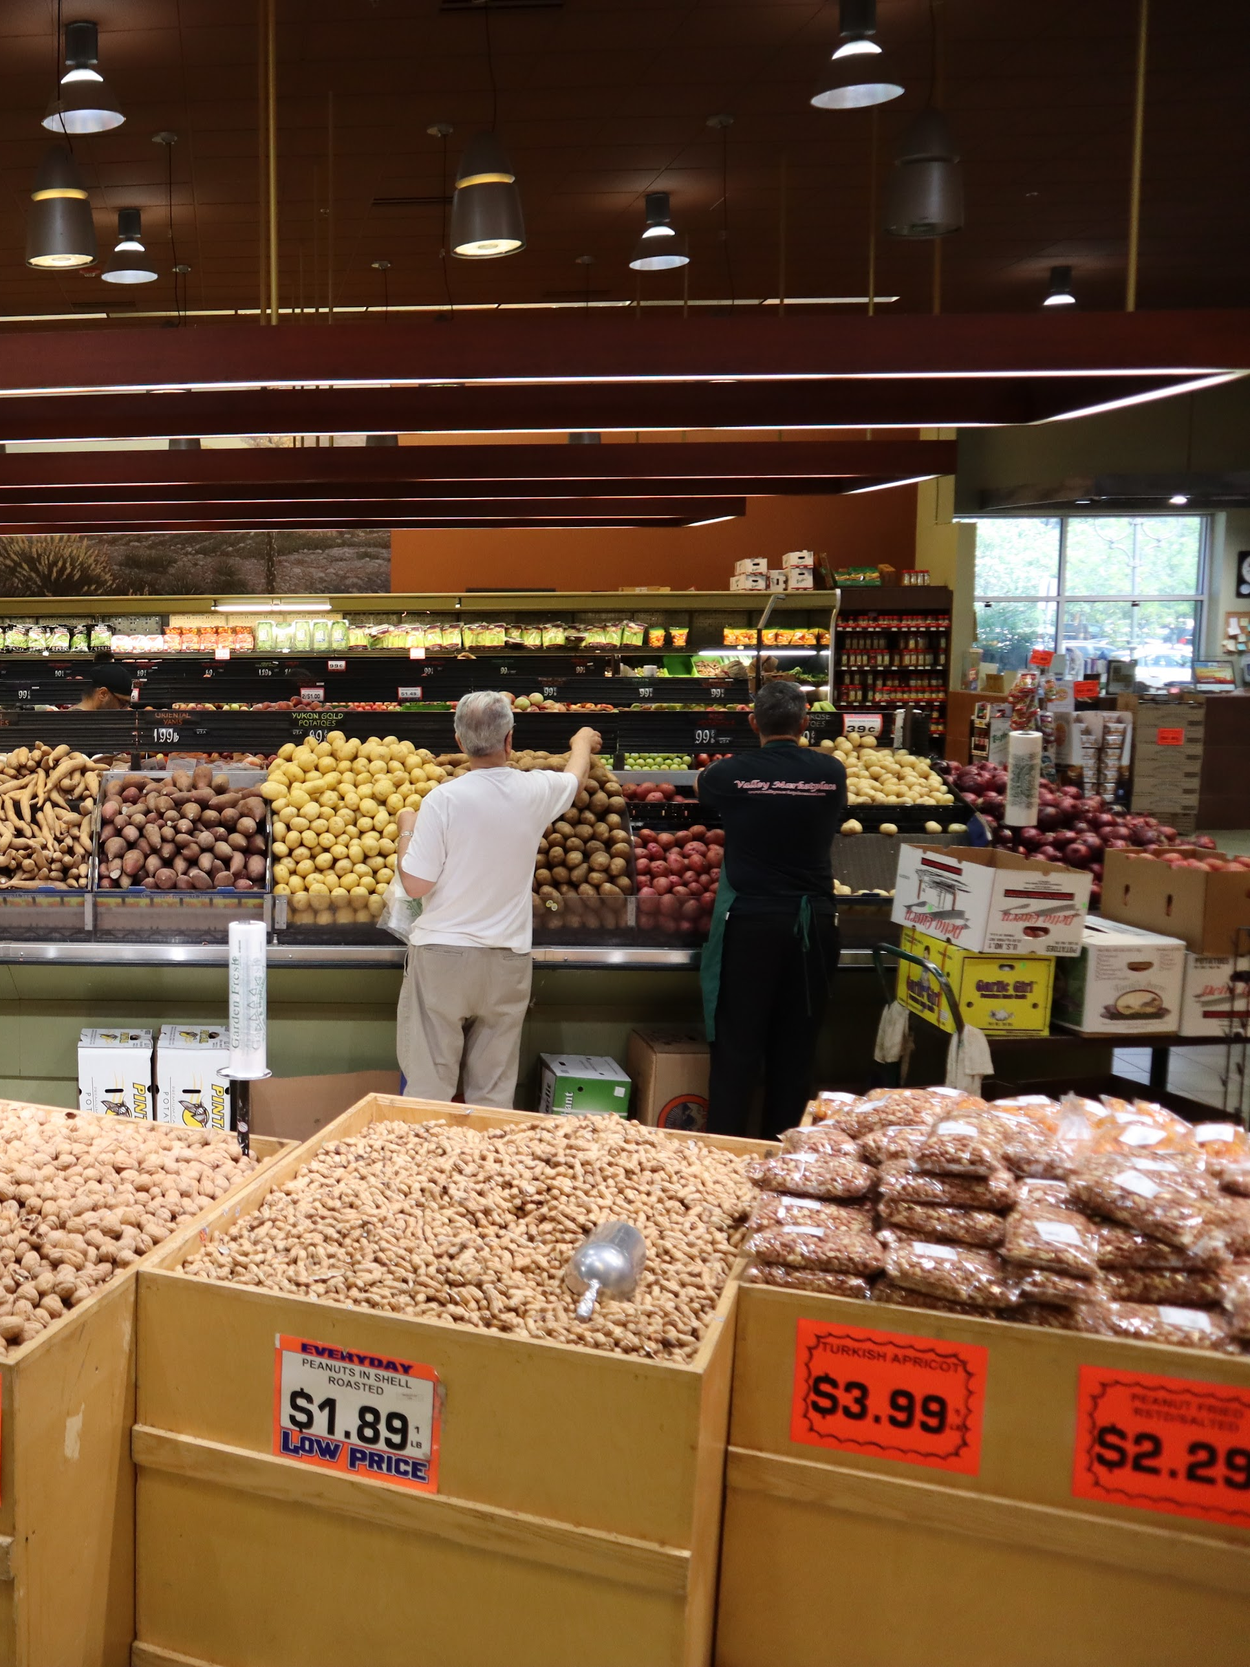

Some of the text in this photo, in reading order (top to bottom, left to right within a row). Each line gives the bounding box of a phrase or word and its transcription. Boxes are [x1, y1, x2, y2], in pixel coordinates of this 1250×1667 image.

[321, 712, 343, 720] GOLD
[734, 779, 837, 792] Valley Marketplace
[975, 979, 1010, 993] Garlic
[231, 1001, 240, 1049] Garden
[301, 1342, 413, 1375] EVERYDAY
[302, 1357, 412, 1389] PEANUTS IN SHELL
[821, 1341, 962, 1373] TURKISH APRICOT
[328, 1377, 384, 1396] ROASTED
[811, 1372, 948, 1434] $3.99
[288, 1387, 409, 1452] $1.89
[281, 1429, 429, 1484] LOW PRICE
[410, 1440, 422, 1449] LB
[1096, 1422, 1250, 1491] $2.29
